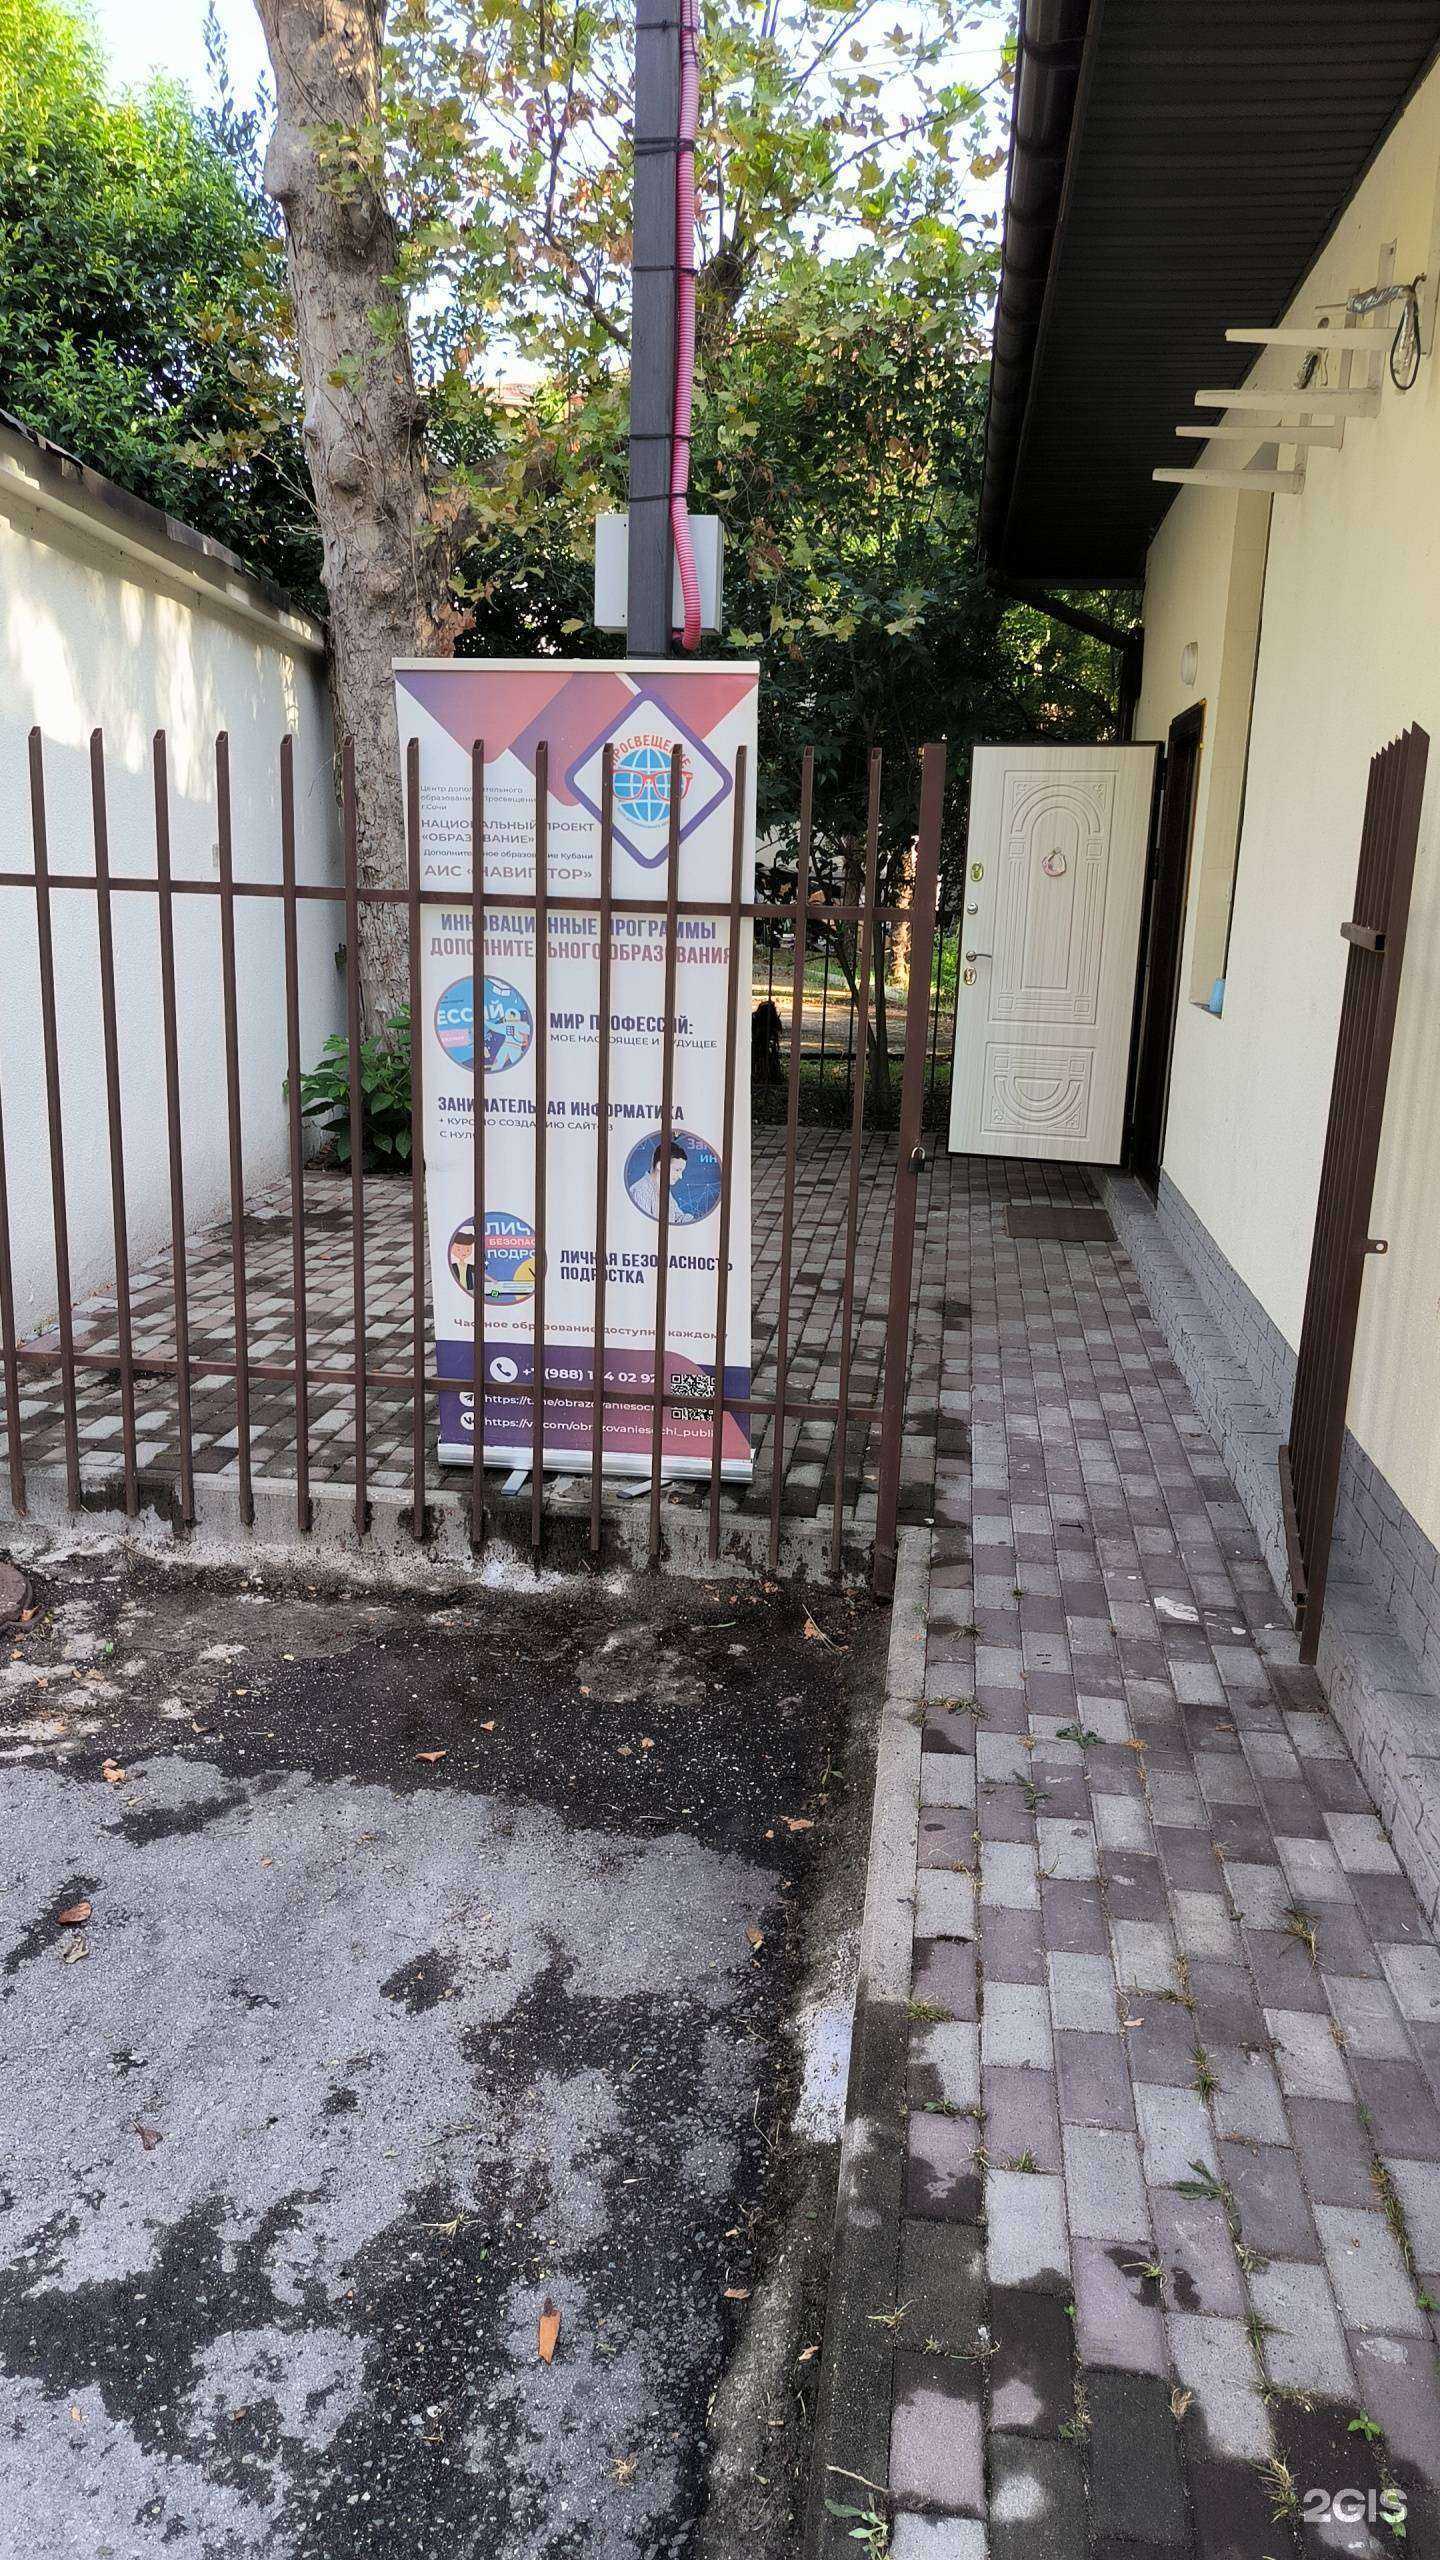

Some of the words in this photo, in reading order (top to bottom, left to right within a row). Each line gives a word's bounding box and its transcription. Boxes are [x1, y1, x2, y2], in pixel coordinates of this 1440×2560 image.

[421, 819, 537, 831] НАЦИОАЛЬНЫЙ
[422, 833, 534, 844] «ОБРАЗВАНИЕ»
[560, 852, 593, 861] Кубани
[424, 865, 462, 877] АИС
[441, 913, 597, 935] ИННВАЦИННЫЕ
[608, 943, 730, 964] ОБРАЗВАНИЯ
[550, 1012, 585, 1029] МИР
[589, 1014, 694, 1034] ПОФЕССЙ:
[550, 1034, 576, 1043] МОЕ
[578, 1035, 649, 1046] НАСОЯЩЕЕ
[651, 1038, 660, 1046] И
[438, 1096, 566, 1115] ЗАНИАТЕЛЬАЯ
[498, 1119, 564, 1129] СОЗДАИЮ
[439, 1130, 447, 1138] С
[449, 1131, 475, 1139] НУЛ
[485, 1221, 531, 1236] ЛИЧ
[560, 1250, 618, 1266] ЛИЧНЯ
[454, 1318, 508, 1329] Часное
[544, 1367, 583, 1381] (988)
[587, 1370, 614, 1381] 14
[618, 1372, 637, 1383] 02
